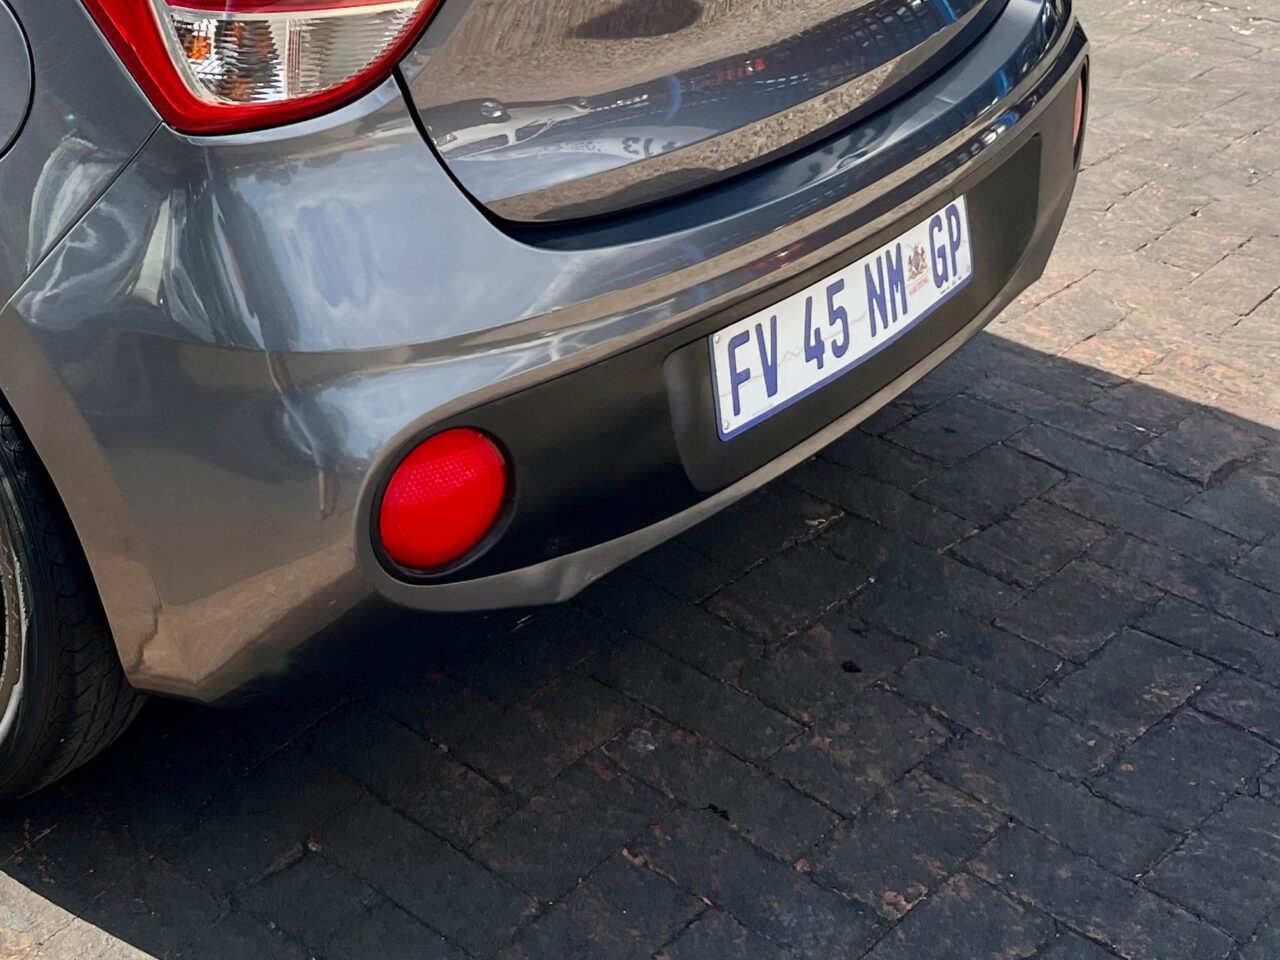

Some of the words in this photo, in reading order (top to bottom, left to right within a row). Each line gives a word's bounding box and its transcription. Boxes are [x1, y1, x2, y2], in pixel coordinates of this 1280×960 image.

[727, 315, 778, 417] FV
[804, 278, 850, 370] 45
[864, 242, 909, 338] NM
[928, 203, 962, 290] GP
